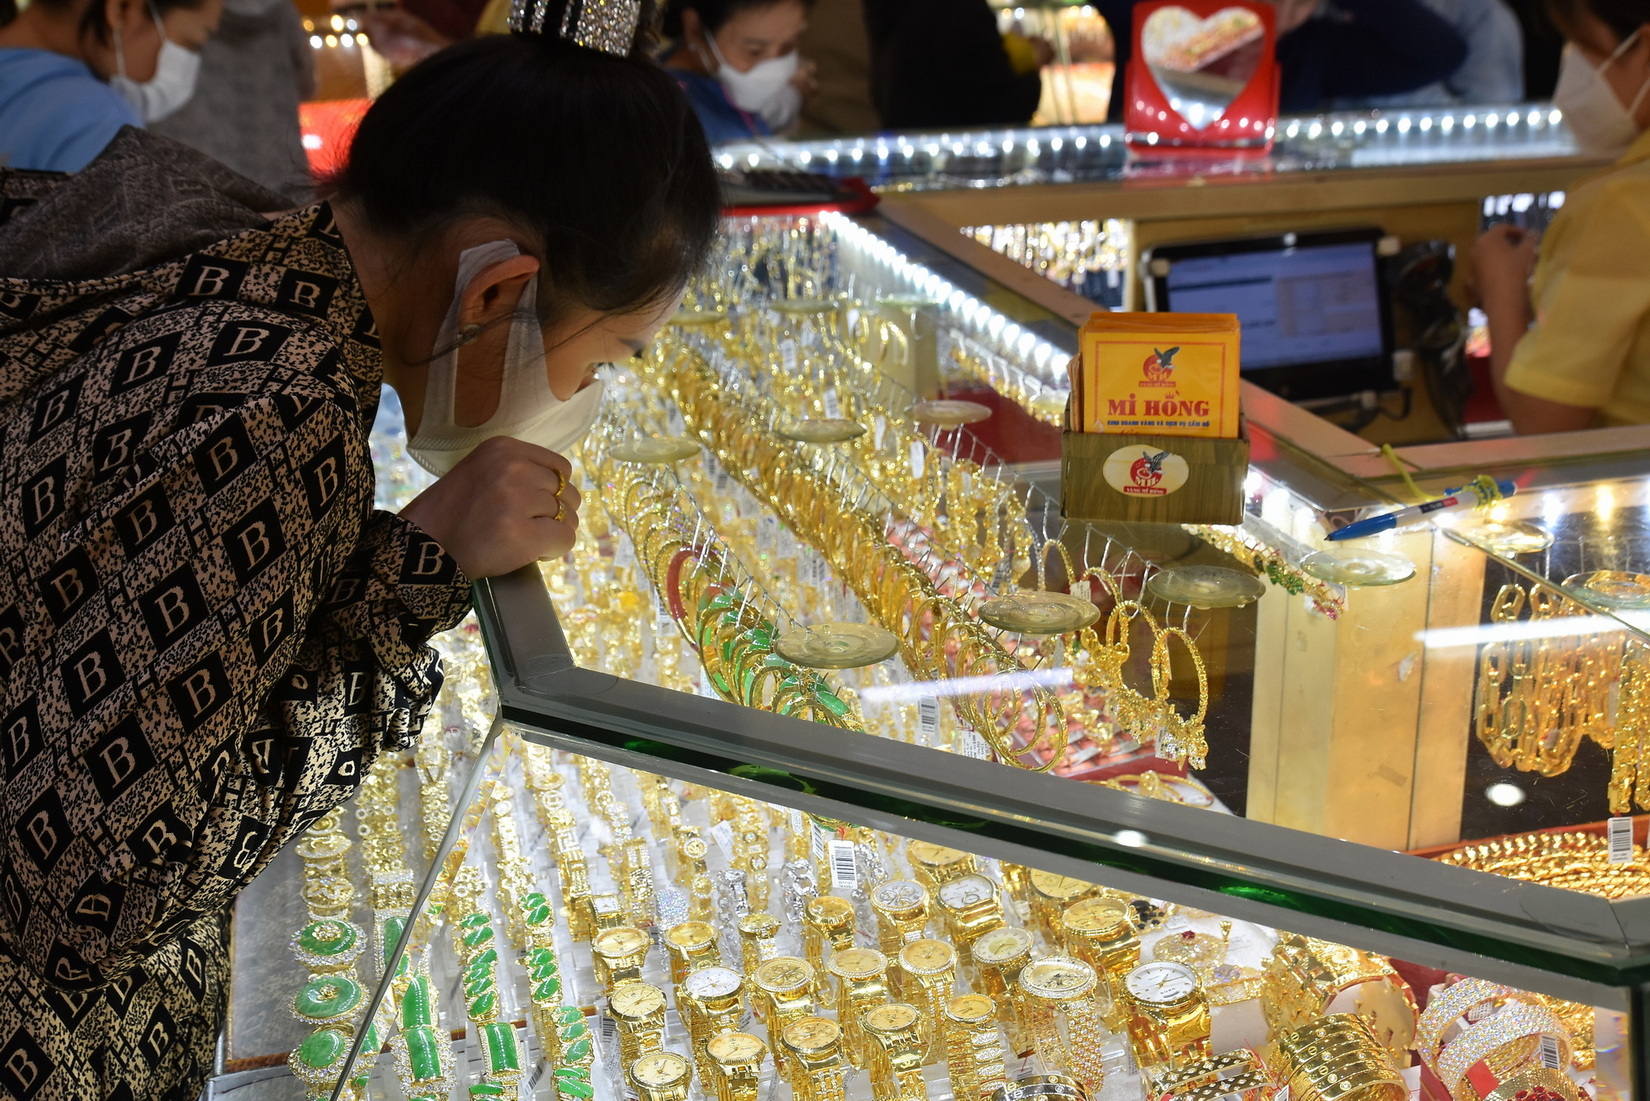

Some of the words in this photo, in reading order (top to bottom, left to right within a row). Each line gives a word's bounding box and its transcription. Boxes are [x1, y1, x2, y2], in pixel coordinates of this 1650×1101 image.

[188, 266, 230, 296] B
[289, 280, 321, 309] B
[223, 327, 270, 357] B
[122, 345, 163, 386] B
[38, 390, 70, 432] B
[99, 428, 133, 472] B
[207, 436, 239, 481] B
[31, 475, 56, 525] B
[313, 456, 339, 508] B
[127, 500, 158, 546] B
[237, 520, 271, 572] B
[412, 541, 446, 575] B
[51, 568, 84, 613] B
[155, 585, 191, 637] B
[261, 608, 284, 653] B
[74, 651, 107, 703] B
[182, 668, 217, 719] B
[8, 716, 30, 767] B
[99, 736, 136, 789] B
[27, 810, 58, 861] B
[148, 1021, 169, 1058] B
[5, 1049, 38, 1093] B
